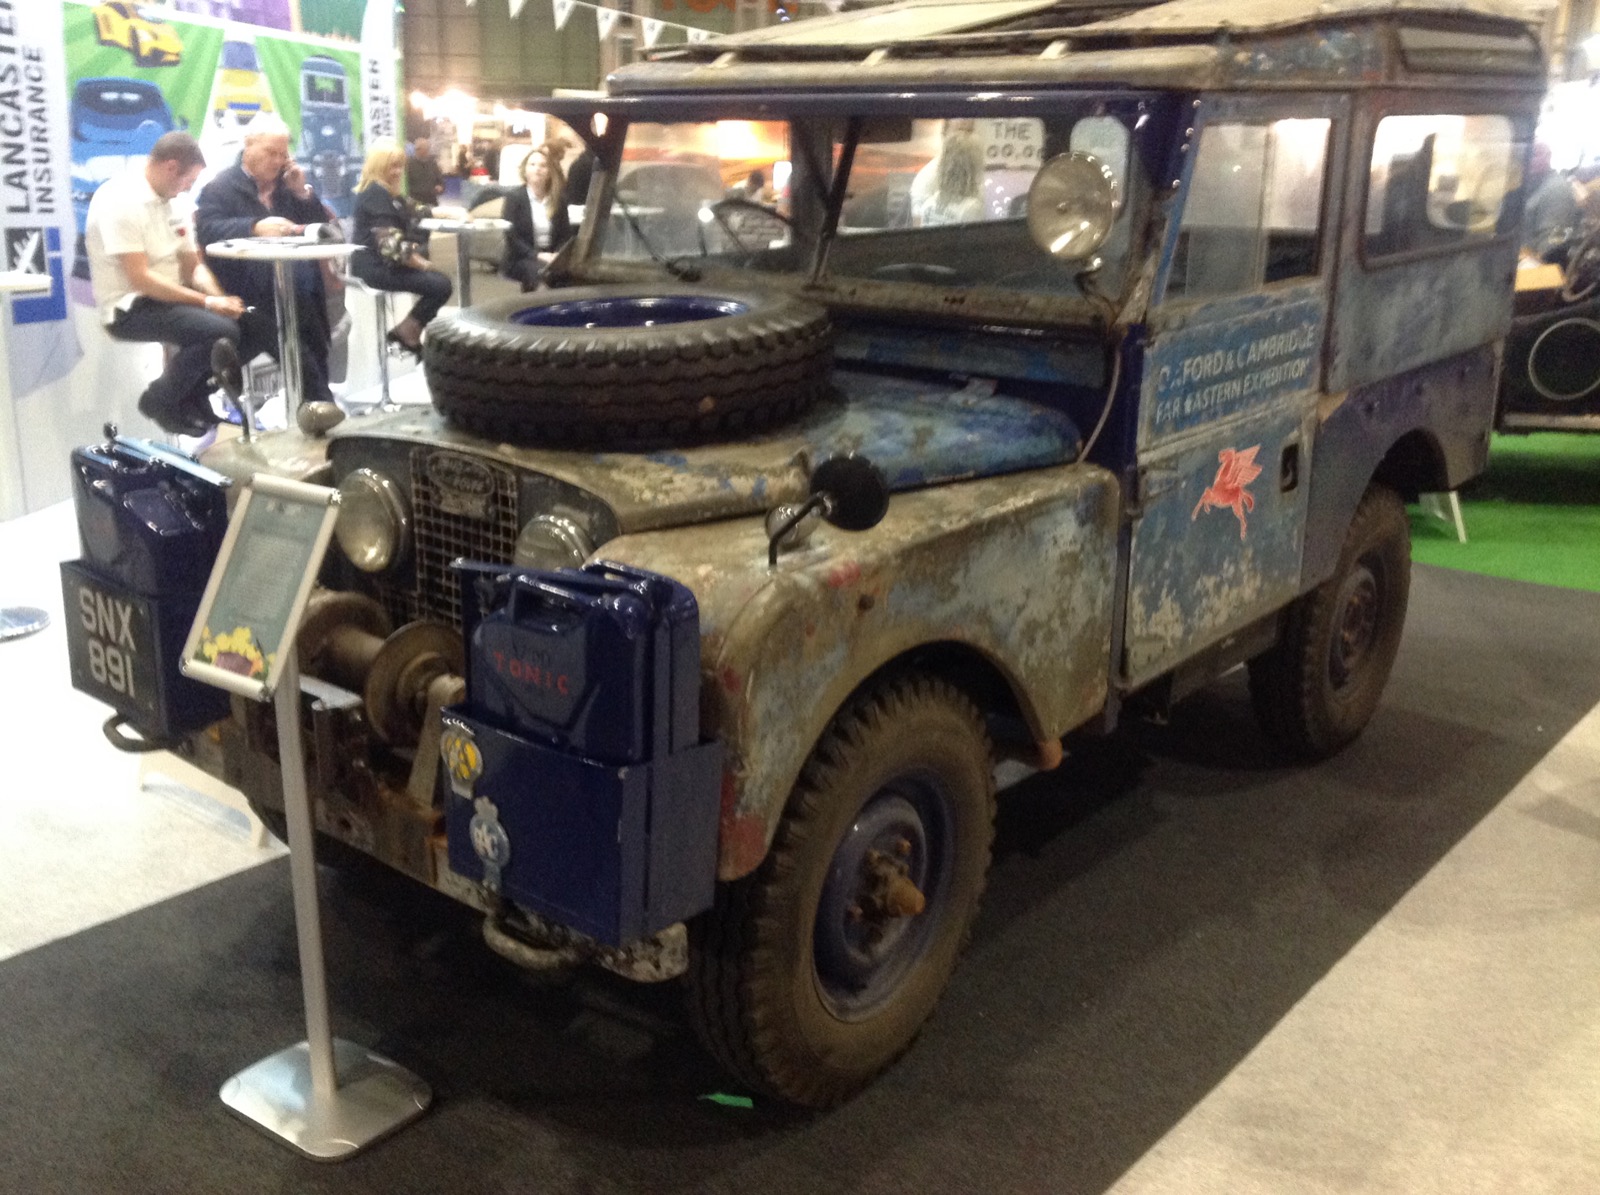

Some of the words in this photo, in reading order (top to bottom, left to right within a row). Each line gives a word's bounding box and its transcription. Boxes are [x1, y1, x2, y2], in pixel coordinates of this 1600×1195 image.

[0, 0, 31, 215] LANCASTE
[22, 45, 55, 215] INSURANCE
[368, 58, 381, 143] ASTER
[1236, 321, 1316, 369] CAMBRIDE
[1155, 396, 1180, 425] FAR
[1243, 357, 1311, 397] EXPEDITION
[79, 587, 137, 653] SNX
[88, 637, 136, 699] 891
[493, 650, 570, 697] TONIC
